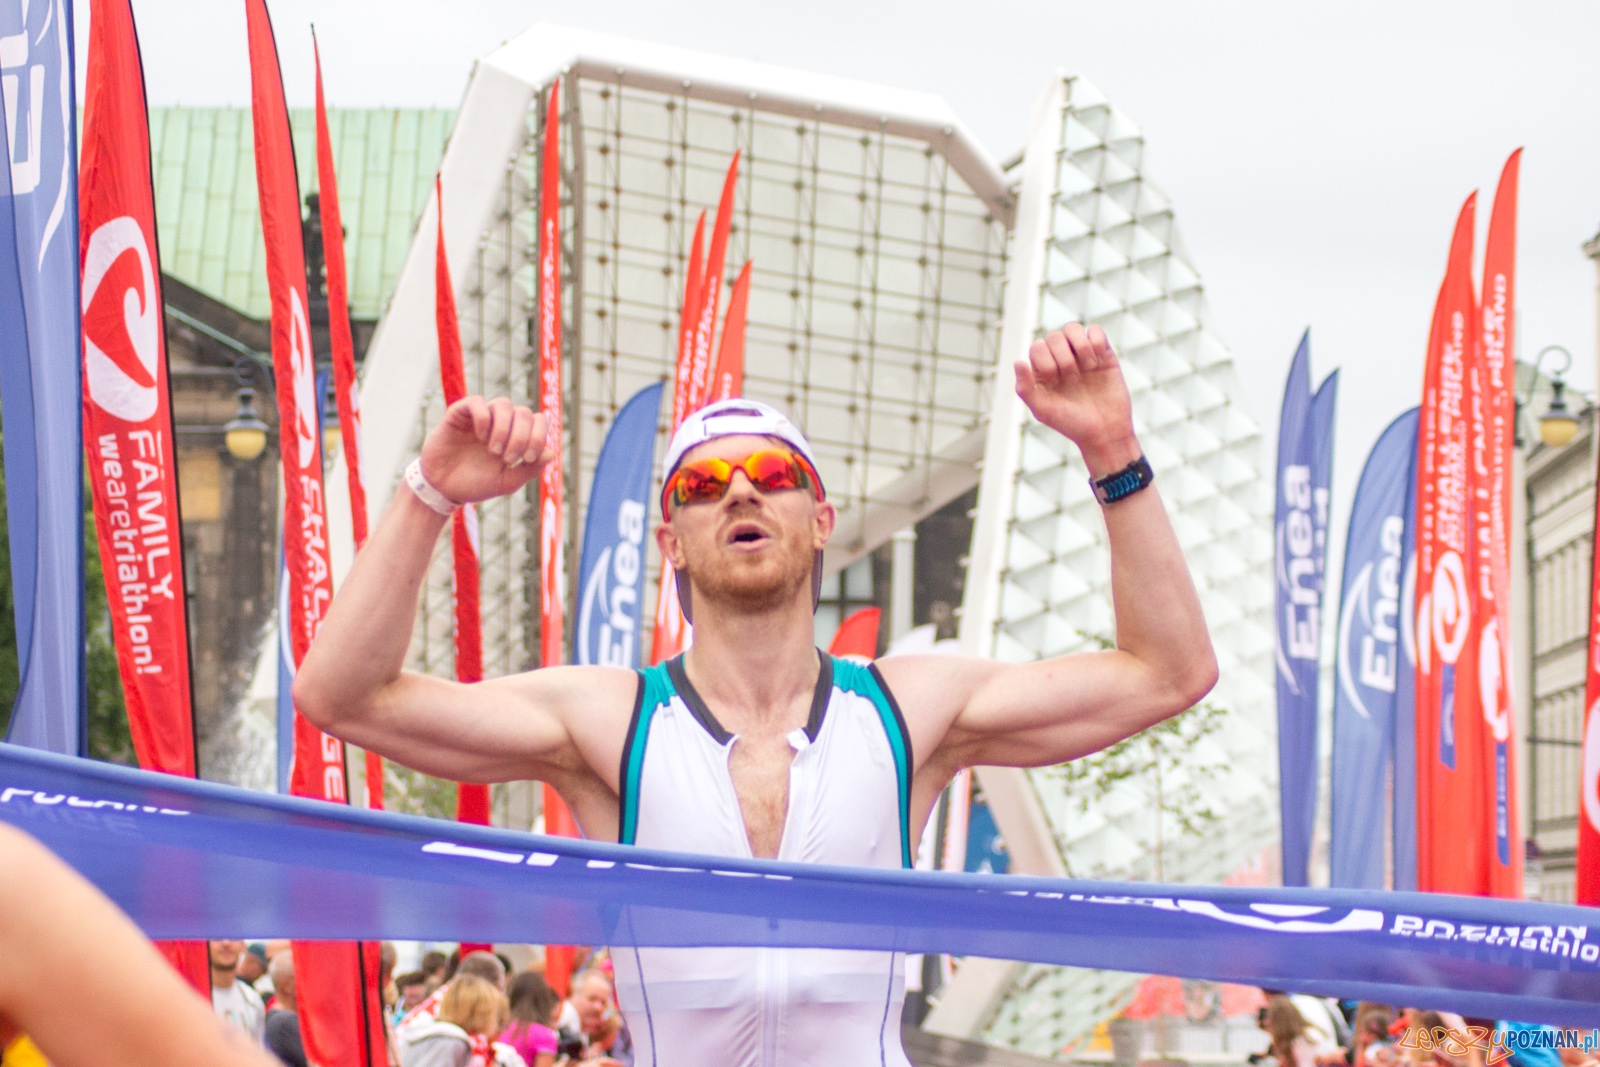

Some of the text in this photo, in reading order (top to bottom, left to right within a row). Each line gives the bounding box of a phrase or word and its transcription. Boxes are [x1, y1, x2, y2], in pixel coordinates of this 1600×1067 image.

[98, 432, 163, 675] wearetriathlon!
[128, 429, 175, 600] FAMILY
[597, 498, 646, 668] Enea
[1283, 463, 1321, 661] Enea
[1359, 514, 1405, 693] Enea
